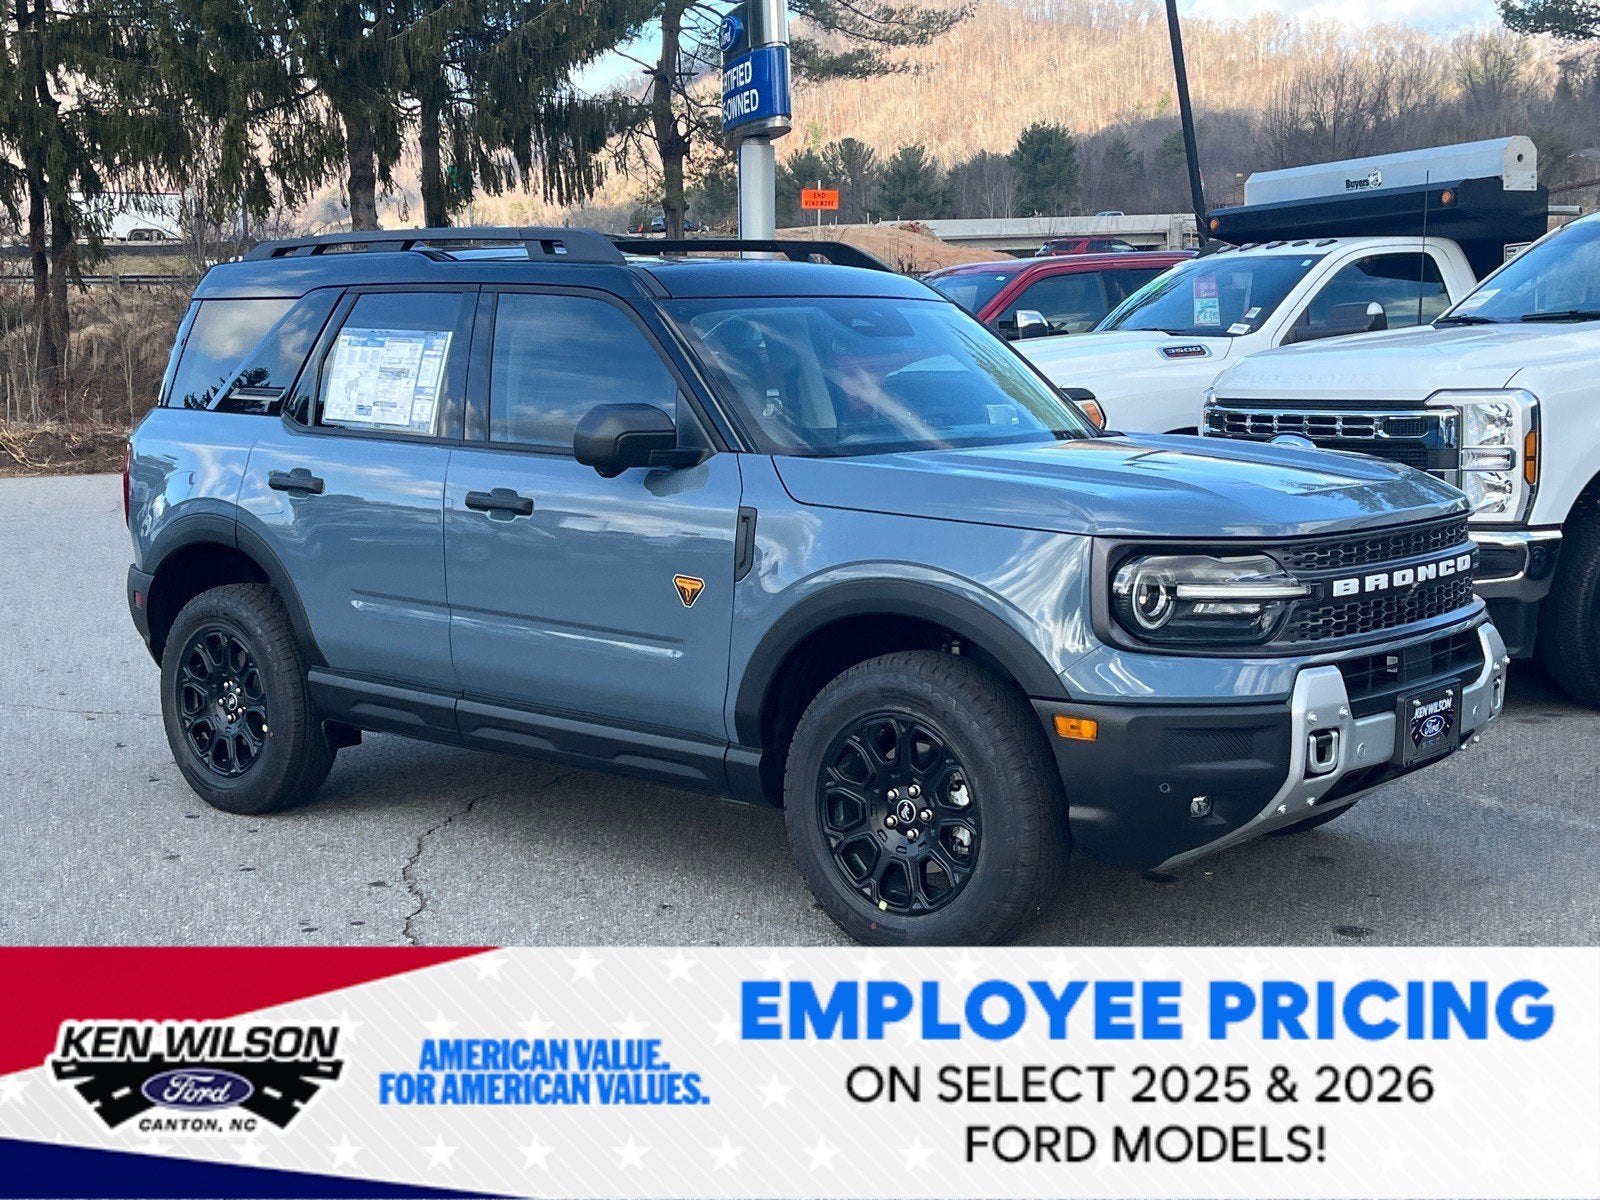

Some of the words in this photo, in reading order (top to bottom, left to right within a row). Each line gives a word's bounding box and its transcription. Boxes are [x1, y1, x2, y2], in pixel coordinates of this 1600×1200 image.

[1345, 179, 1370, 190] Buyers
[1332, 554, 1472, 597] BRONCO
[1413, 704, 1429, 720] KEN
[1427, 697, 1453, 715] WILSON
